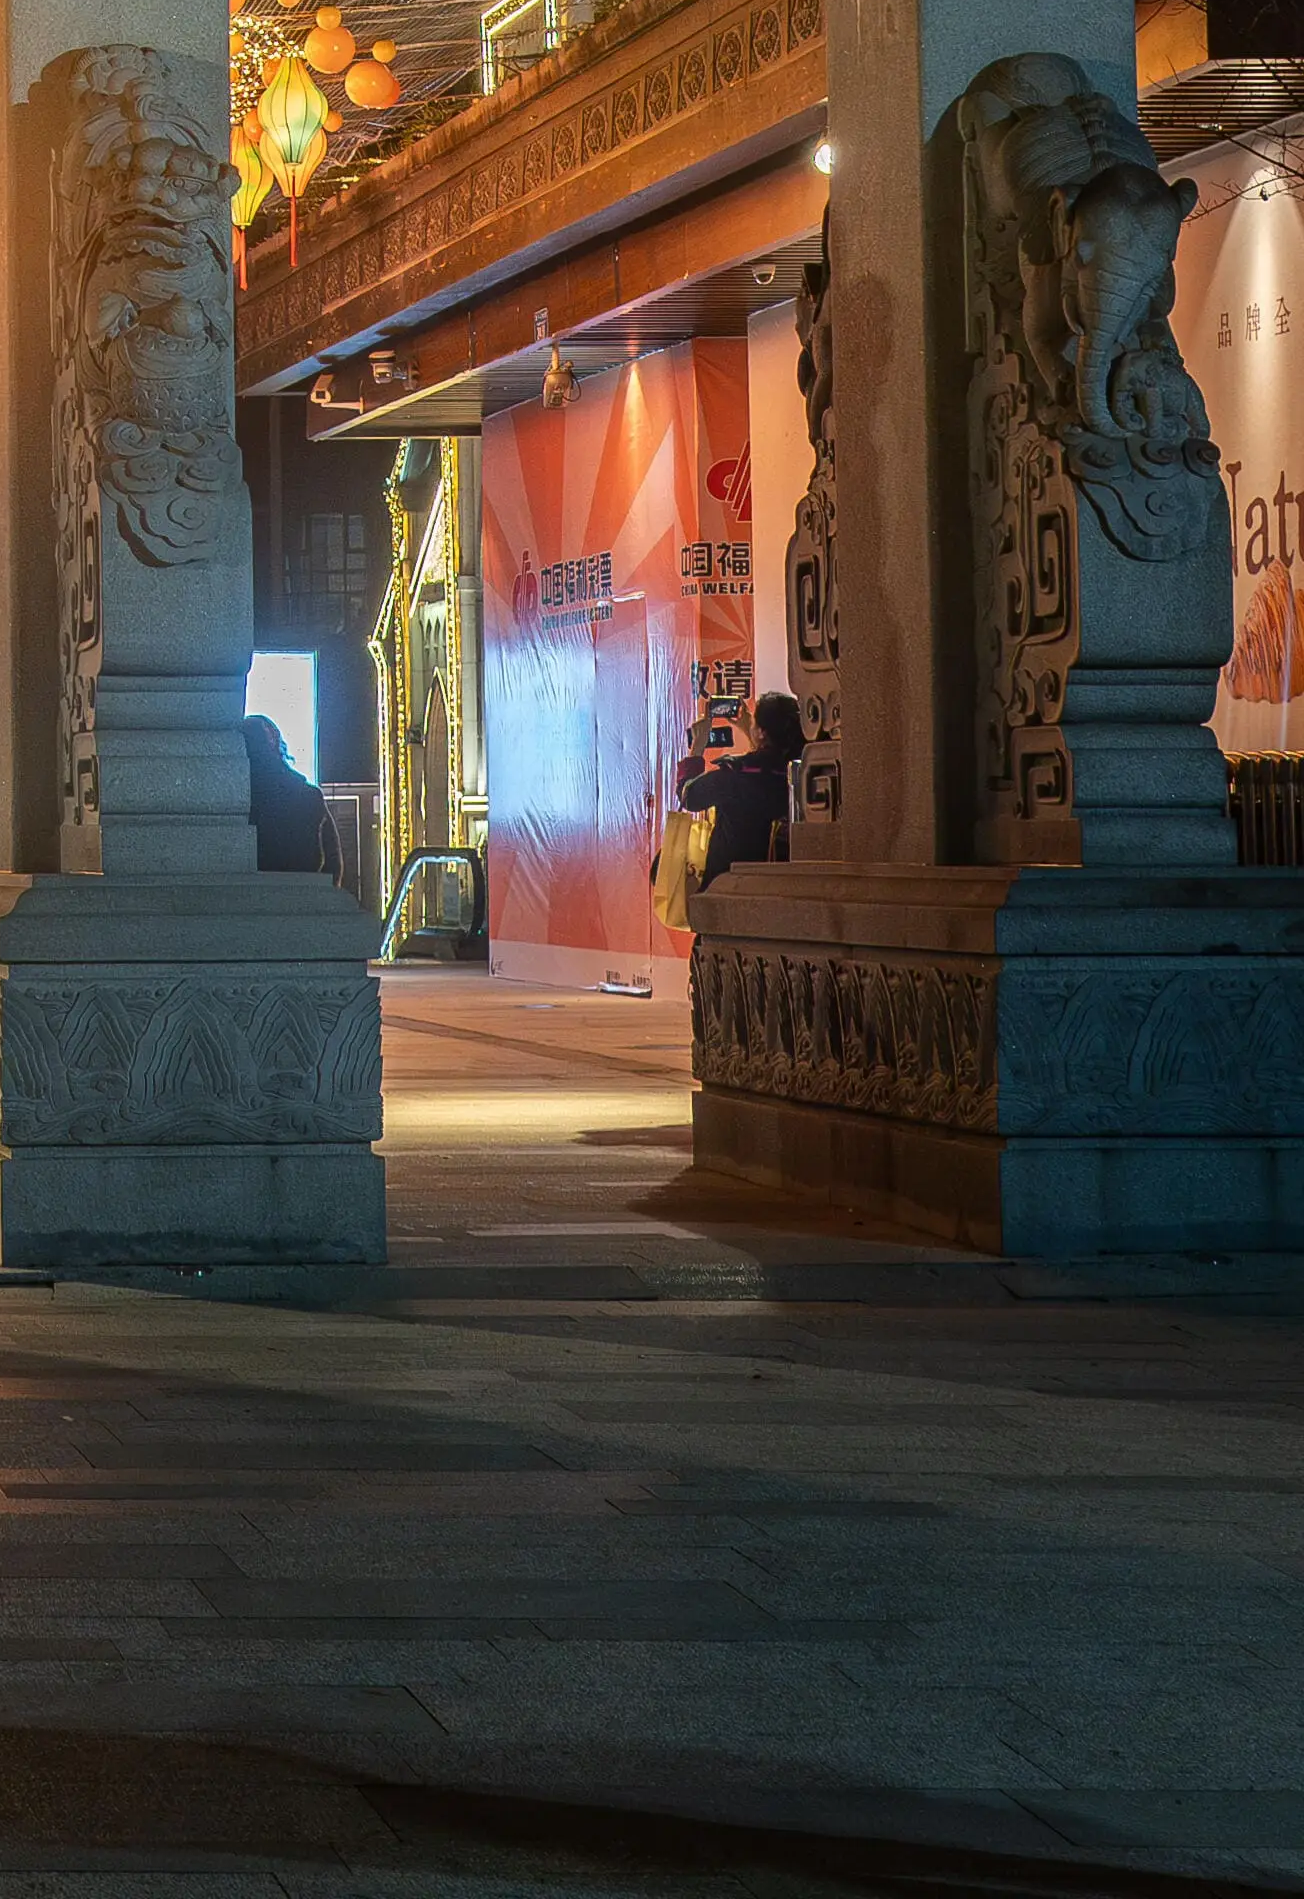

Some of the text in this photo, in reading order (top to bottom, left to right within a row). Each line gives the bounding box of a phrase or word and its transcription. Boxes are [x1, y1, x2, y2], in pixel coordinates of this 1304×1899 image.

[1217, 295, 1292, 349] 品牌全
[541, 551, 613, 607] 中国福利彩票
